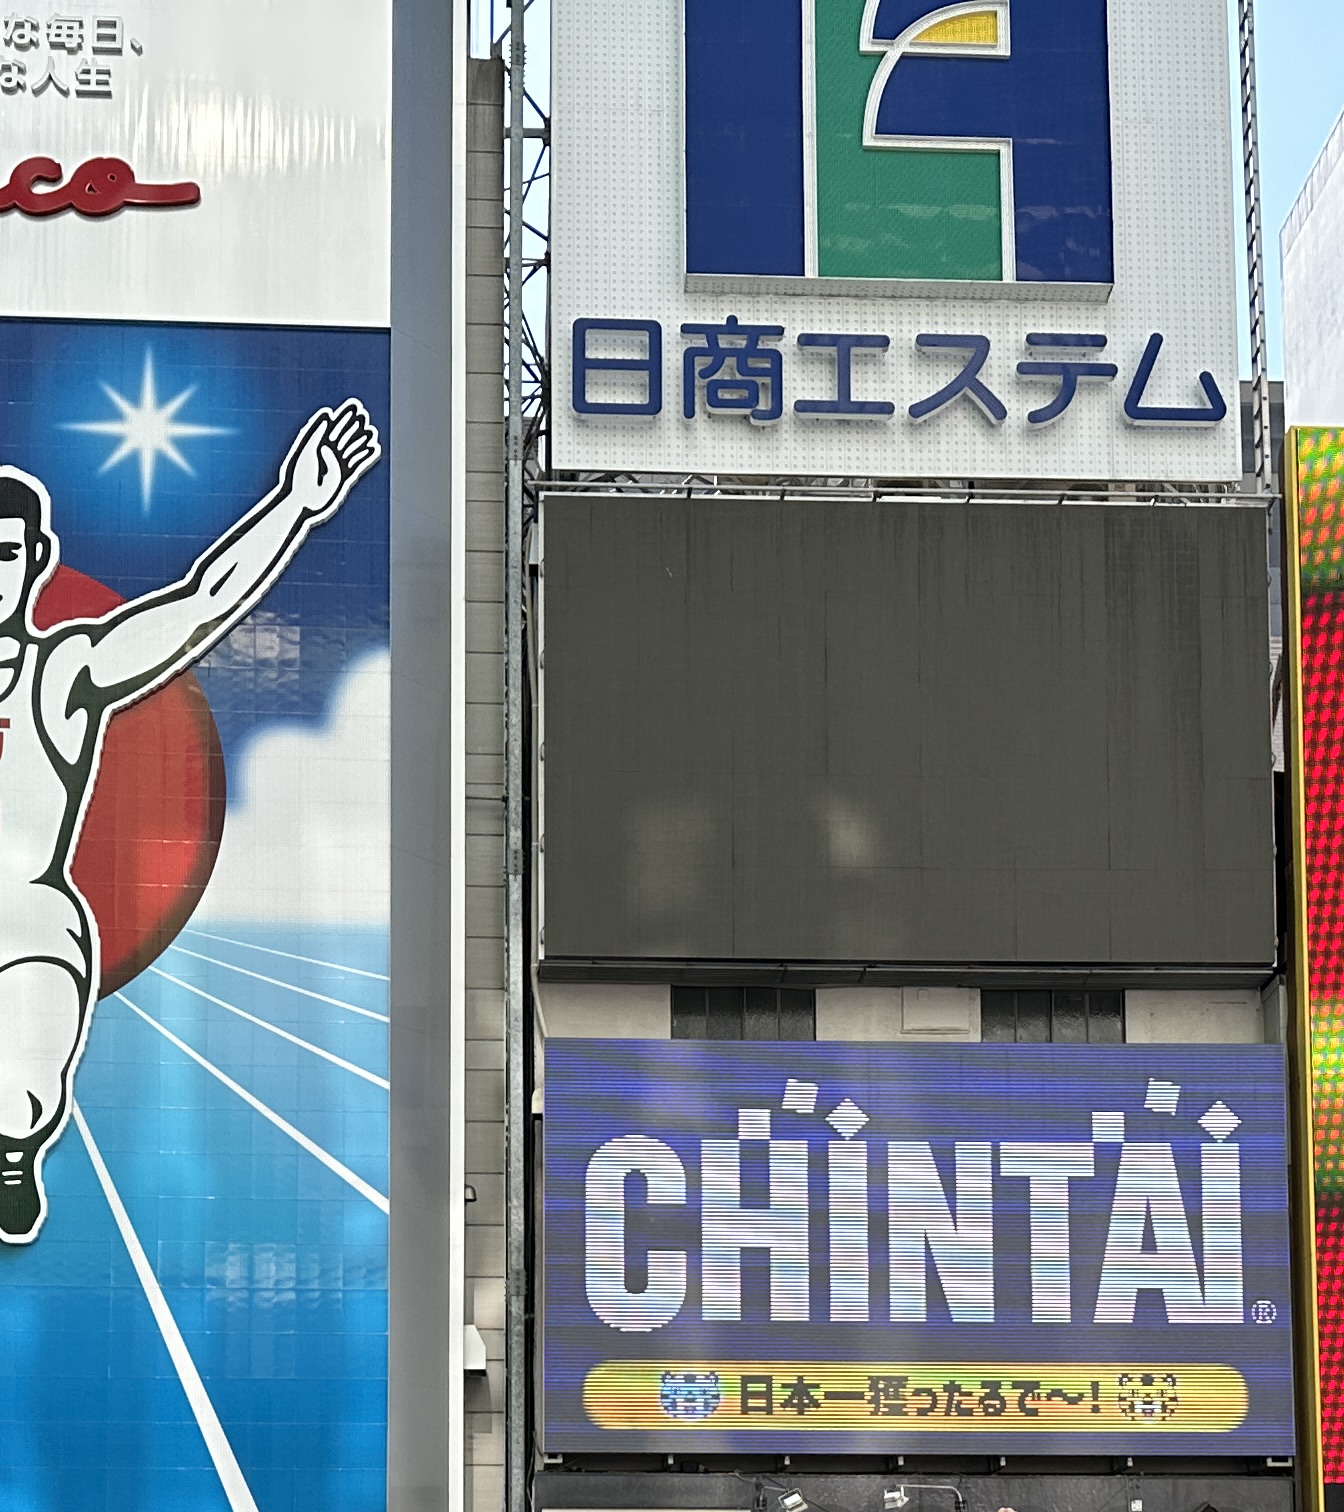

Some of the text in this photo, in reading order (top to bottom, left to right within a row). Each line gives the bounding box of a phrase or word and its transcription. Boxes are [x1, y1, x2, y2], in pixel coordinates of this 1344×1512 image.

[572, 314, 1227, 428] 日商エステム
[584, 1078, 1245, 1333] CHINTAI
